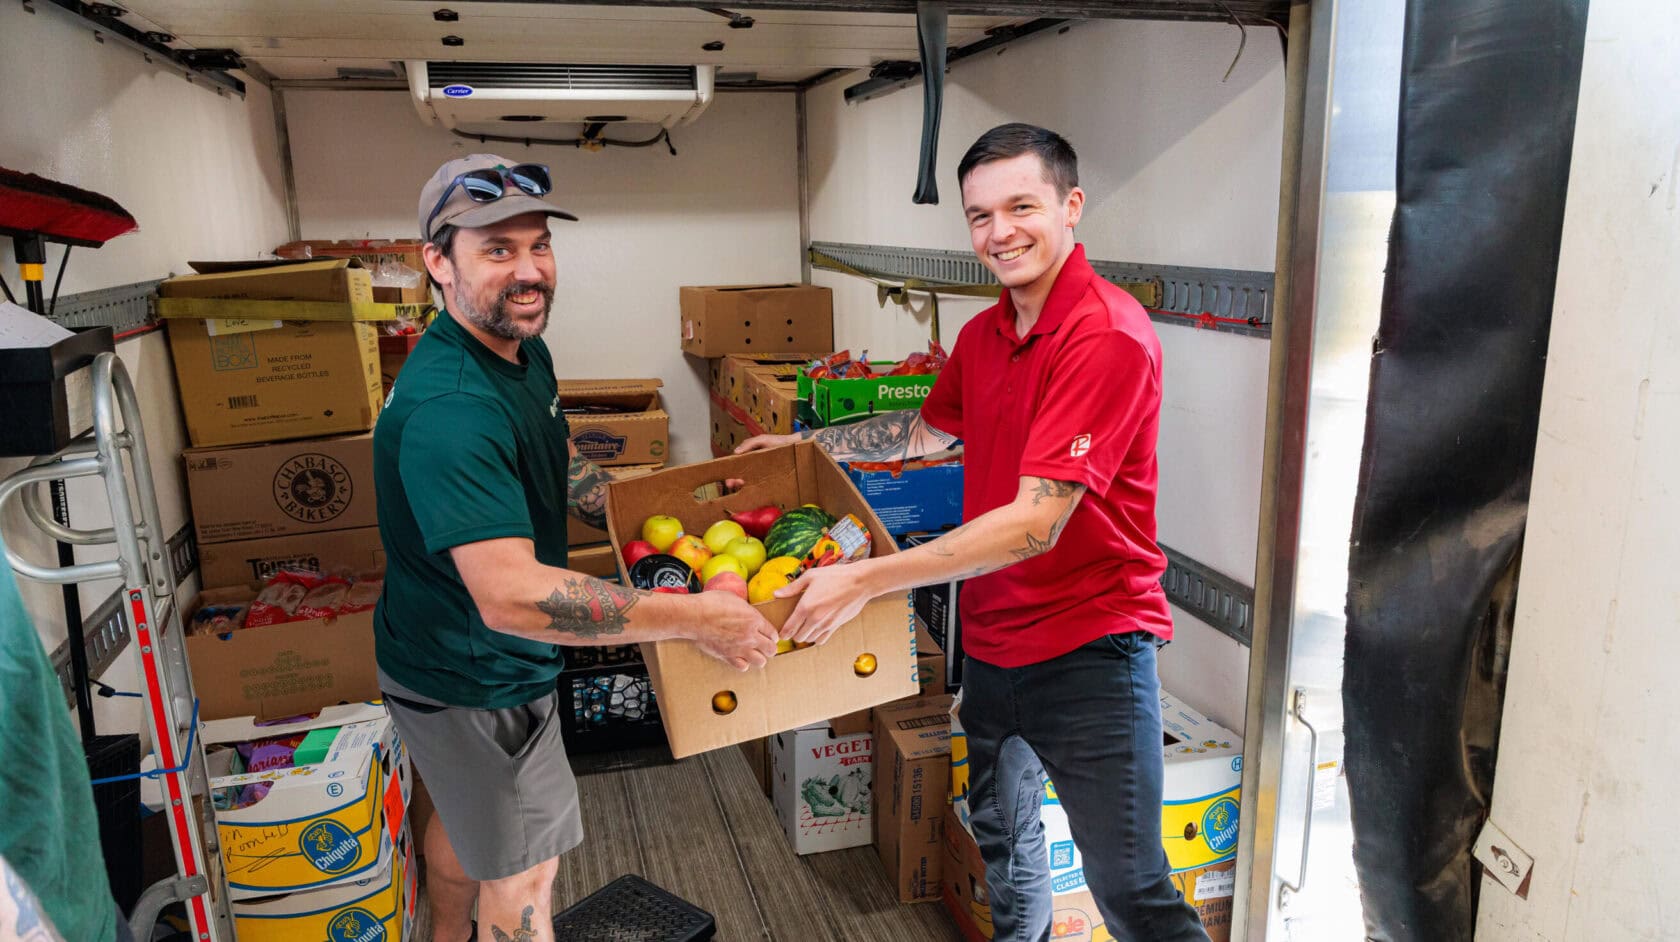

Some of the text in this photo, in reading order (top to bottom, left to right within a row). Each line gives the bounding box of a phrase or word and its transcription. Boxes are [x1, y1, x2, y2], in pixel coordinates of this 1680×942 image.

[267, 353, 312, 363] MADE FROM
[272, 363, 311, 373] RECYCLED
[256, 370, 329, 383] BEVERAGE BOTTLES
[878, 384, 931, 399] Presto
[278, 457, 345, 489] CHABASO
[285, 496, 345, 520] BAKERY
[315, 837, 358, 871] Chiquita
[1056, 880, 1078, 891] CLASS
